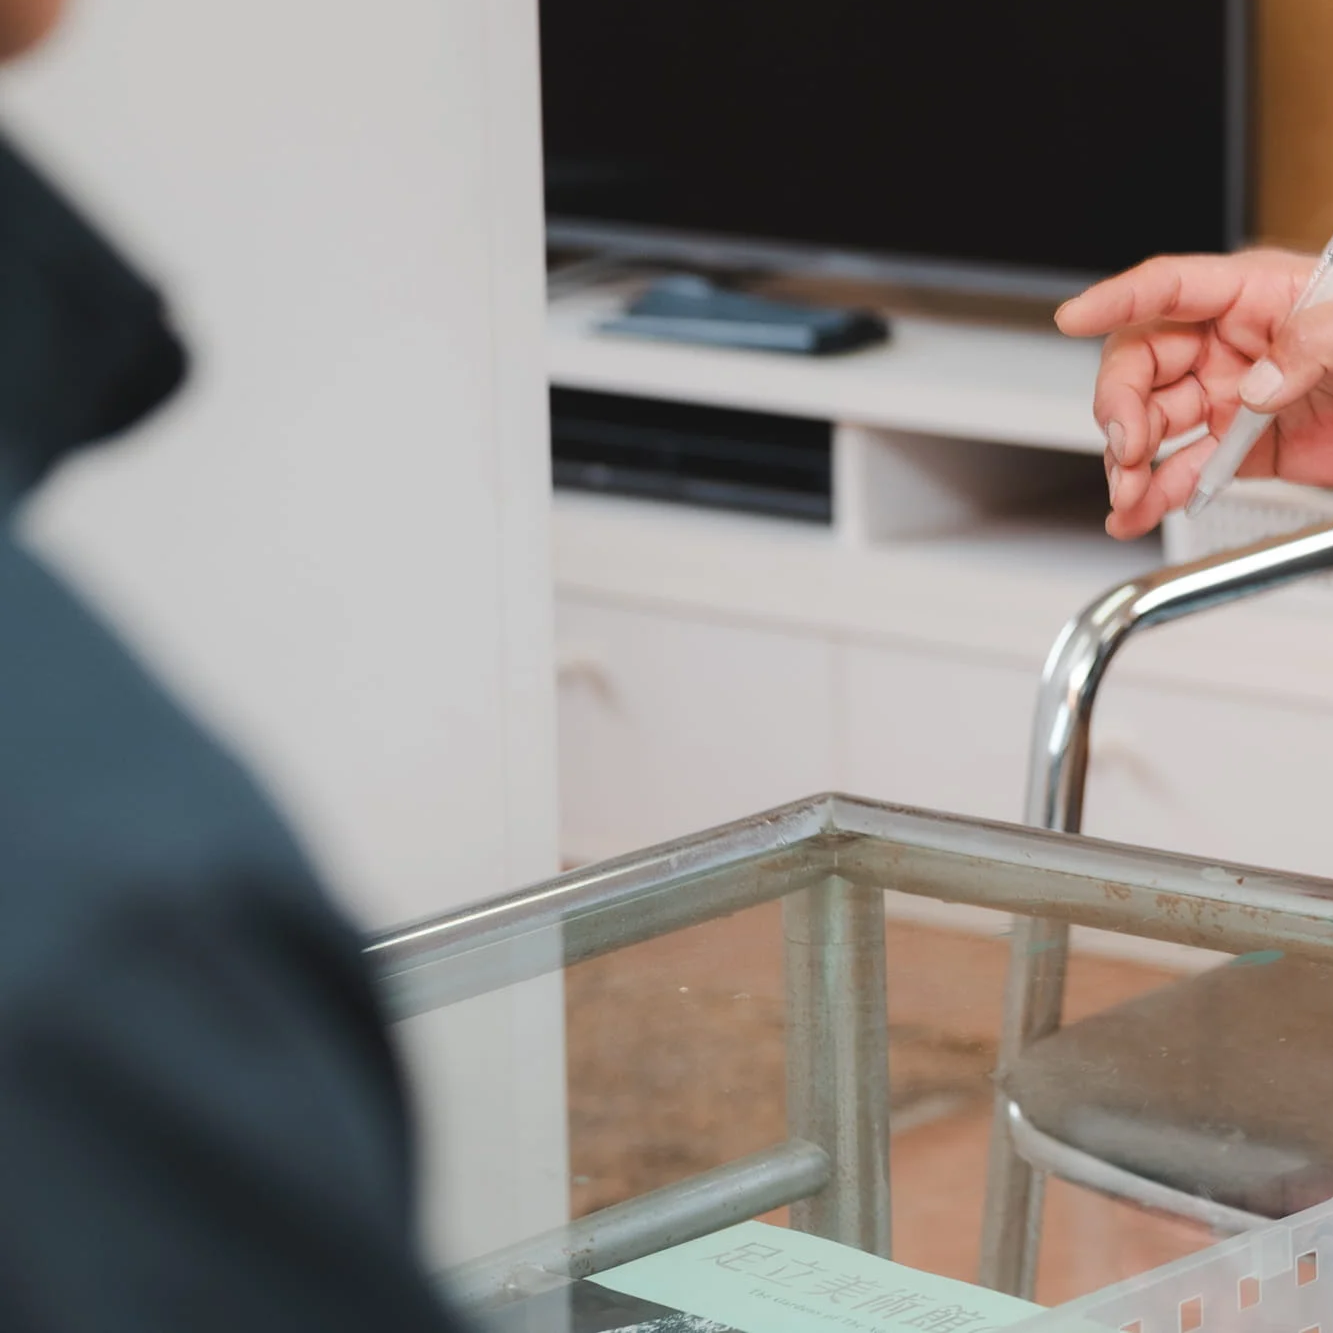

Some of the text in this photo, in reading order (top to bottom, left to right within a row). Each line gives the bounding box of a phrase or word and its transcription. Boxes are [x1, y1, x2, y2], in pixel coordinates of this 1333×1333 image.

[696, 1242, 1000, 1333] 足立美術館
